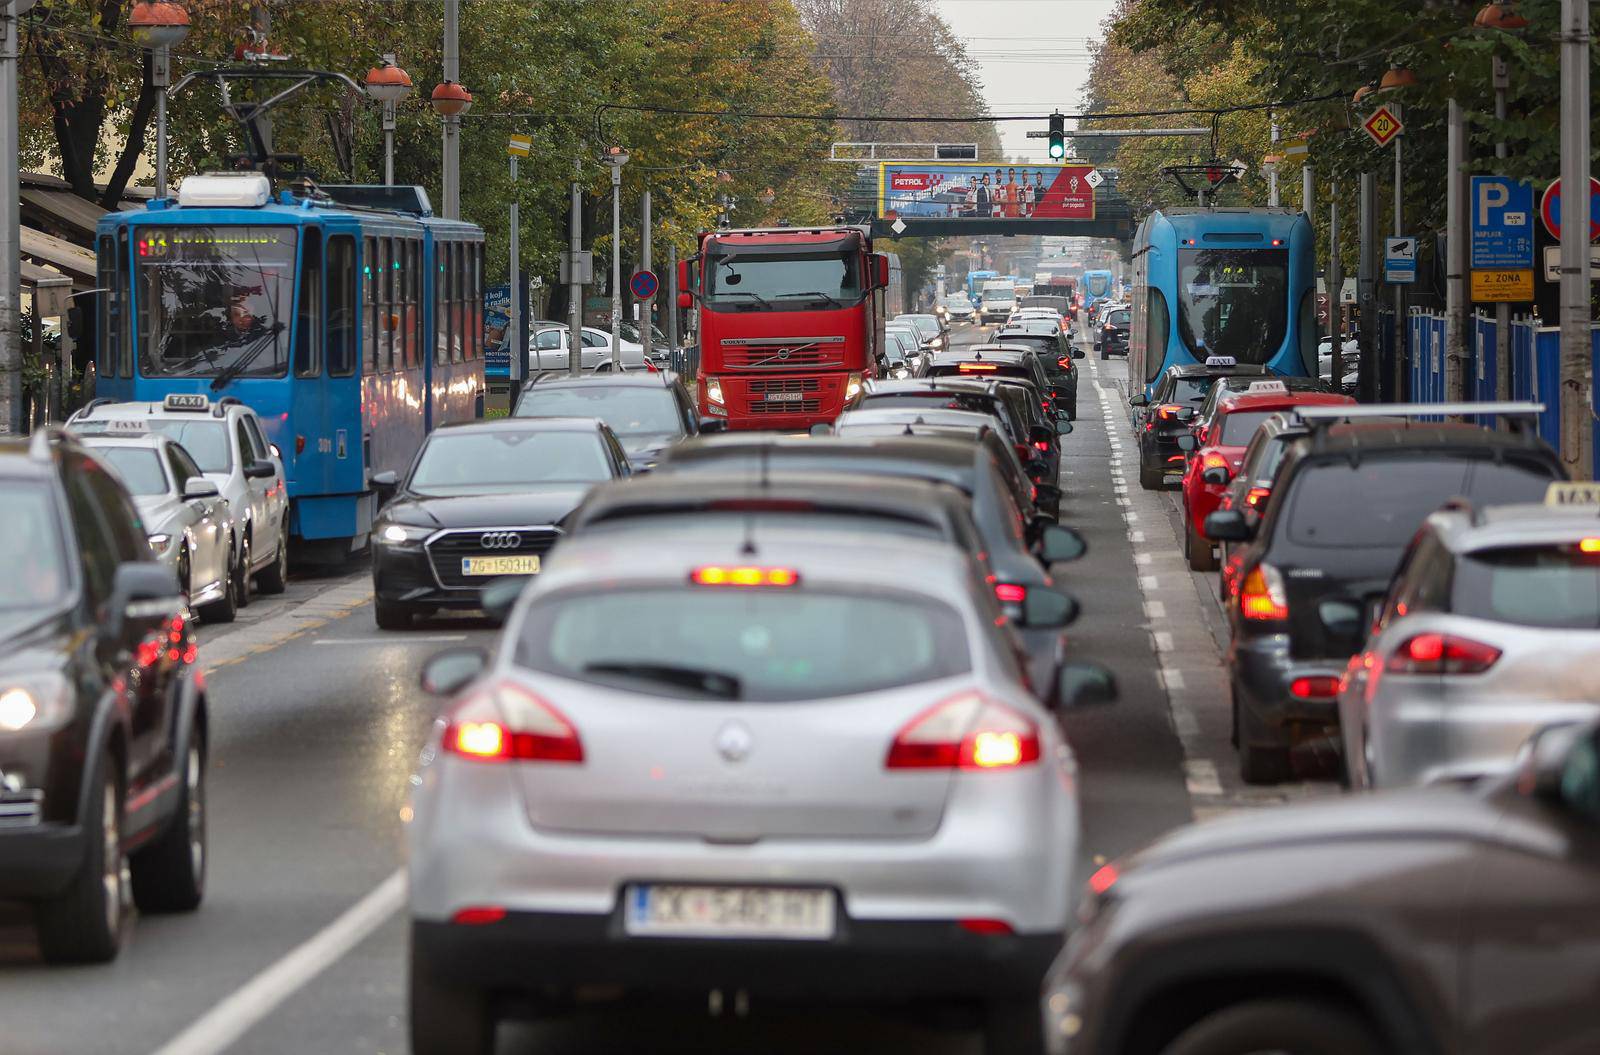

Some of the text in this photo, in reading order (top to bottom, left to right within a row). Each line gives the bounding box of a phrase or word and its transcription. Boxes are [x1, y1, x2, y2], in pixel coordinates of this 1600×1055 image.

[1377, 119, 1389, 131] 20
[894, 178, 923, 186] PETROL
[1091, 175, 1097, 183] S
[1479, 183, 1509, 226] P
[1484, 274, 1521, 283] 2. ZONA
[489, 290, 503, 300] koji
[172, 397, 202, 406] TAXI
[115, 421, 142, 429] TAXI
